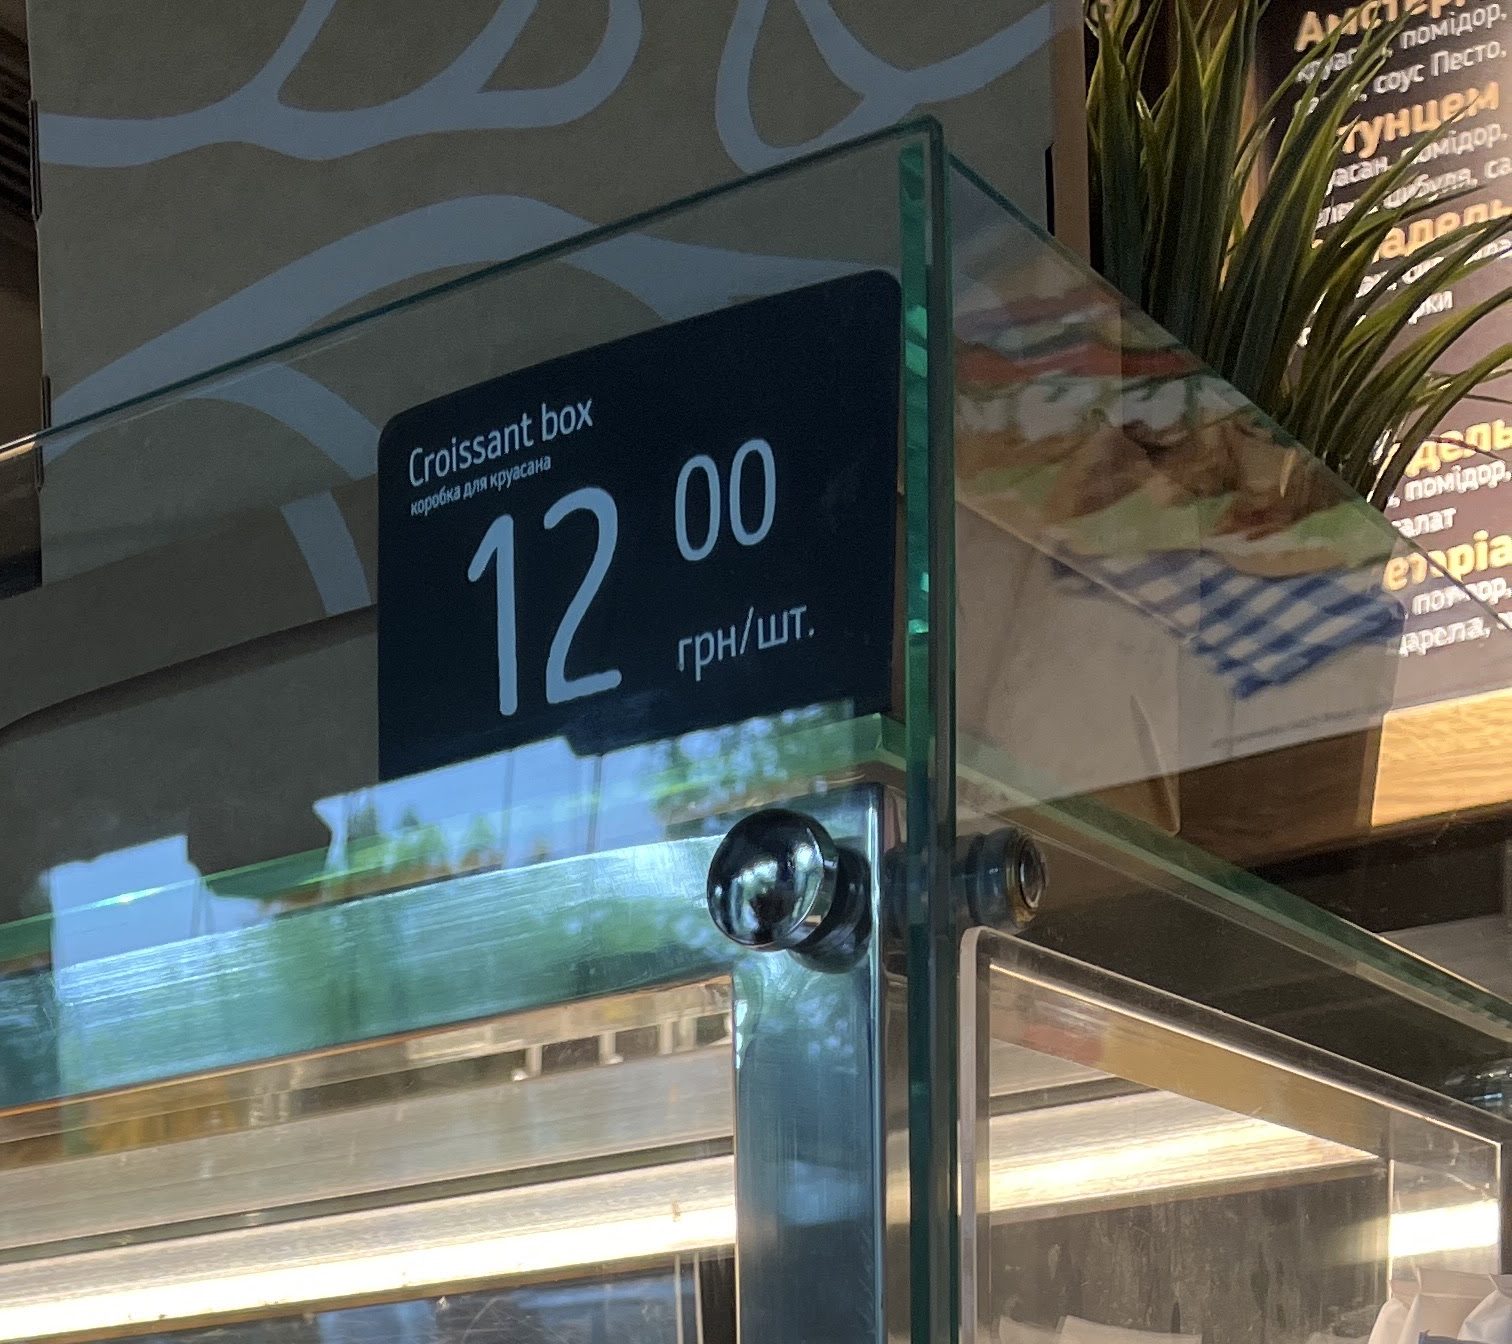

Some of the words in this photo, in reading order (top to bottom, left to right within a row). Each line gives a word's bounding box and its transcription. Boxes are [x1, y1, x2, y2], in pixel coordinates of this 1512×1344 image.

[1373, 63, 1426, 94] соус
[408, 411, 535, 488] Croissant
[541, 397, 594, 442] box
[410, 485, 461, 517] коробка
[463, 474, 488, 500] для
[489, 454, 551, 492] круасана
[1404, 459, 1512, 502] помідор,
[467, 486, 623, 717] 12
[674, 438, 777, 562] 00
[676, 604, 816, 681] грн/шт.
